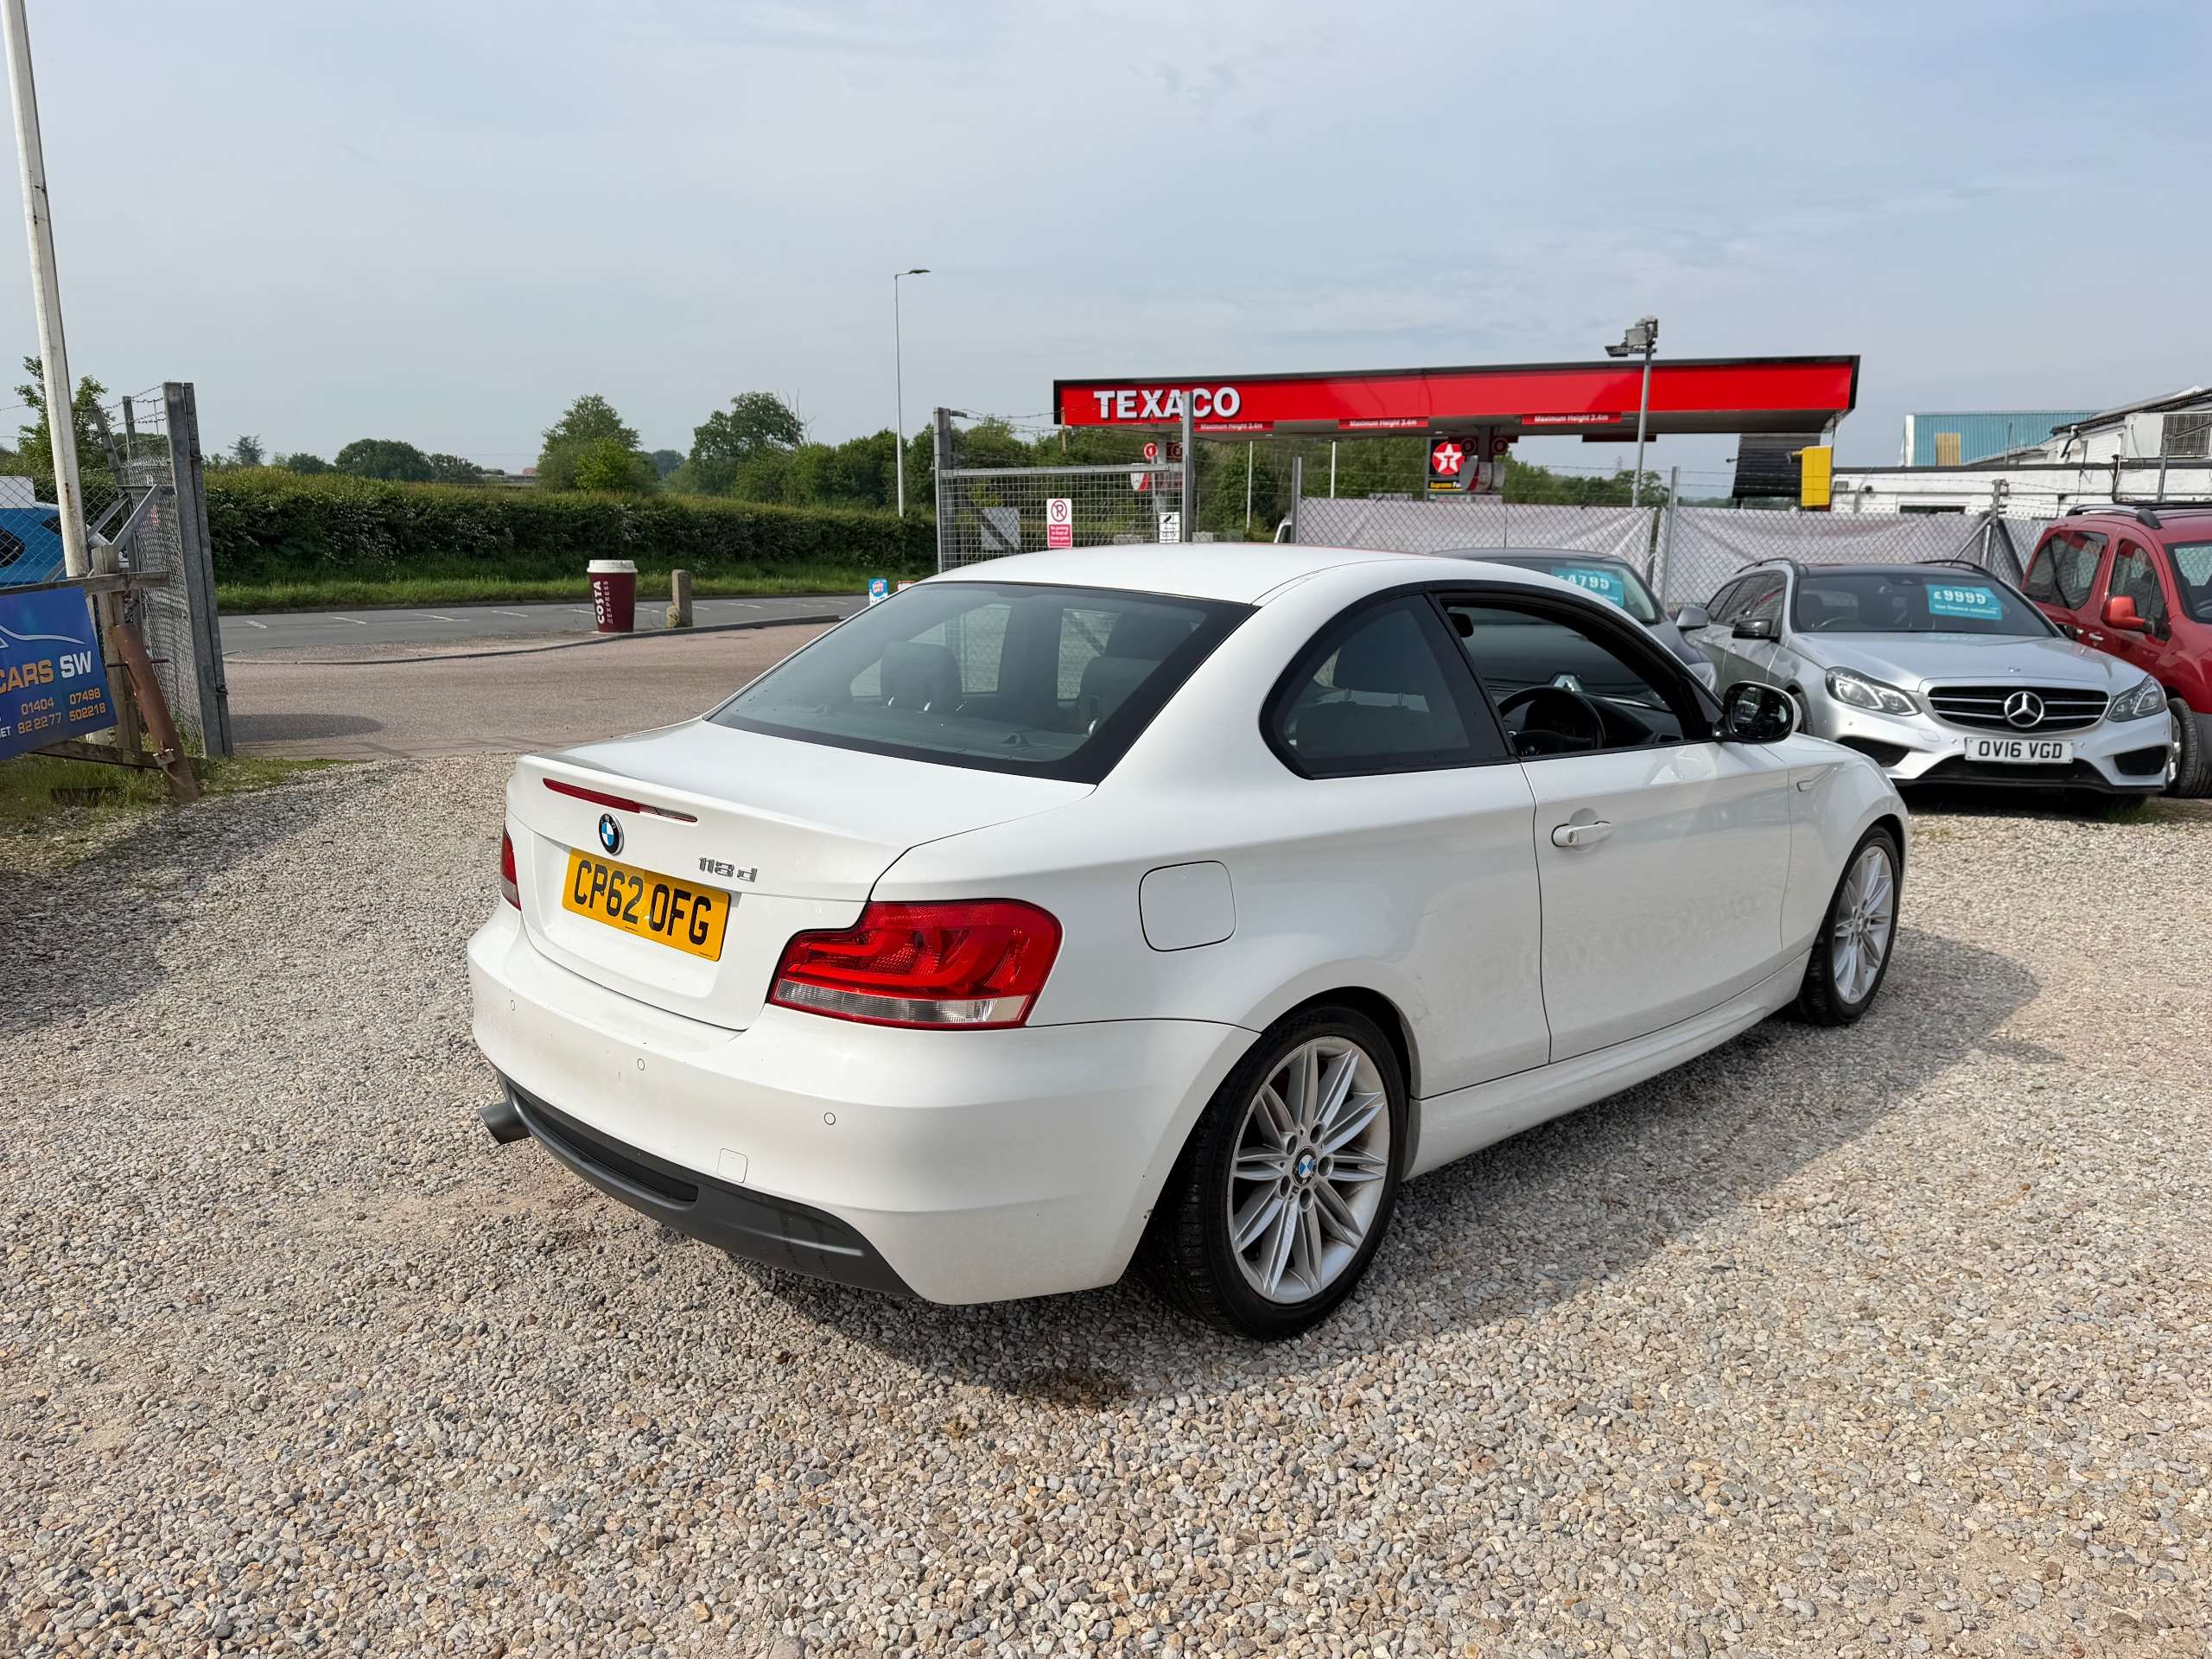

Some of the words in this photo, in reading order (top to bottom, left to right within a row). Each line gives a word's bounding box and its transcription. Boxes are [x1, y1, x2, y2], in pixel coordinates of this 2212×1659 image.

[1093, 387, 1241, 419] TEXACO
[593, 580, 605, 625] COSTA
[60, 651, 92, 679] SW
[21, 696, 55, 715] 01404
[0, 726, 11, 739] ET
[1978, 741, 2023, 759] OV16
[2029, 741, 2063, 760] VGD
[698, 856, 759, 883] 118d
[573, 860, 644, 925] CP62
[648, 883, 712, 946] OFG
